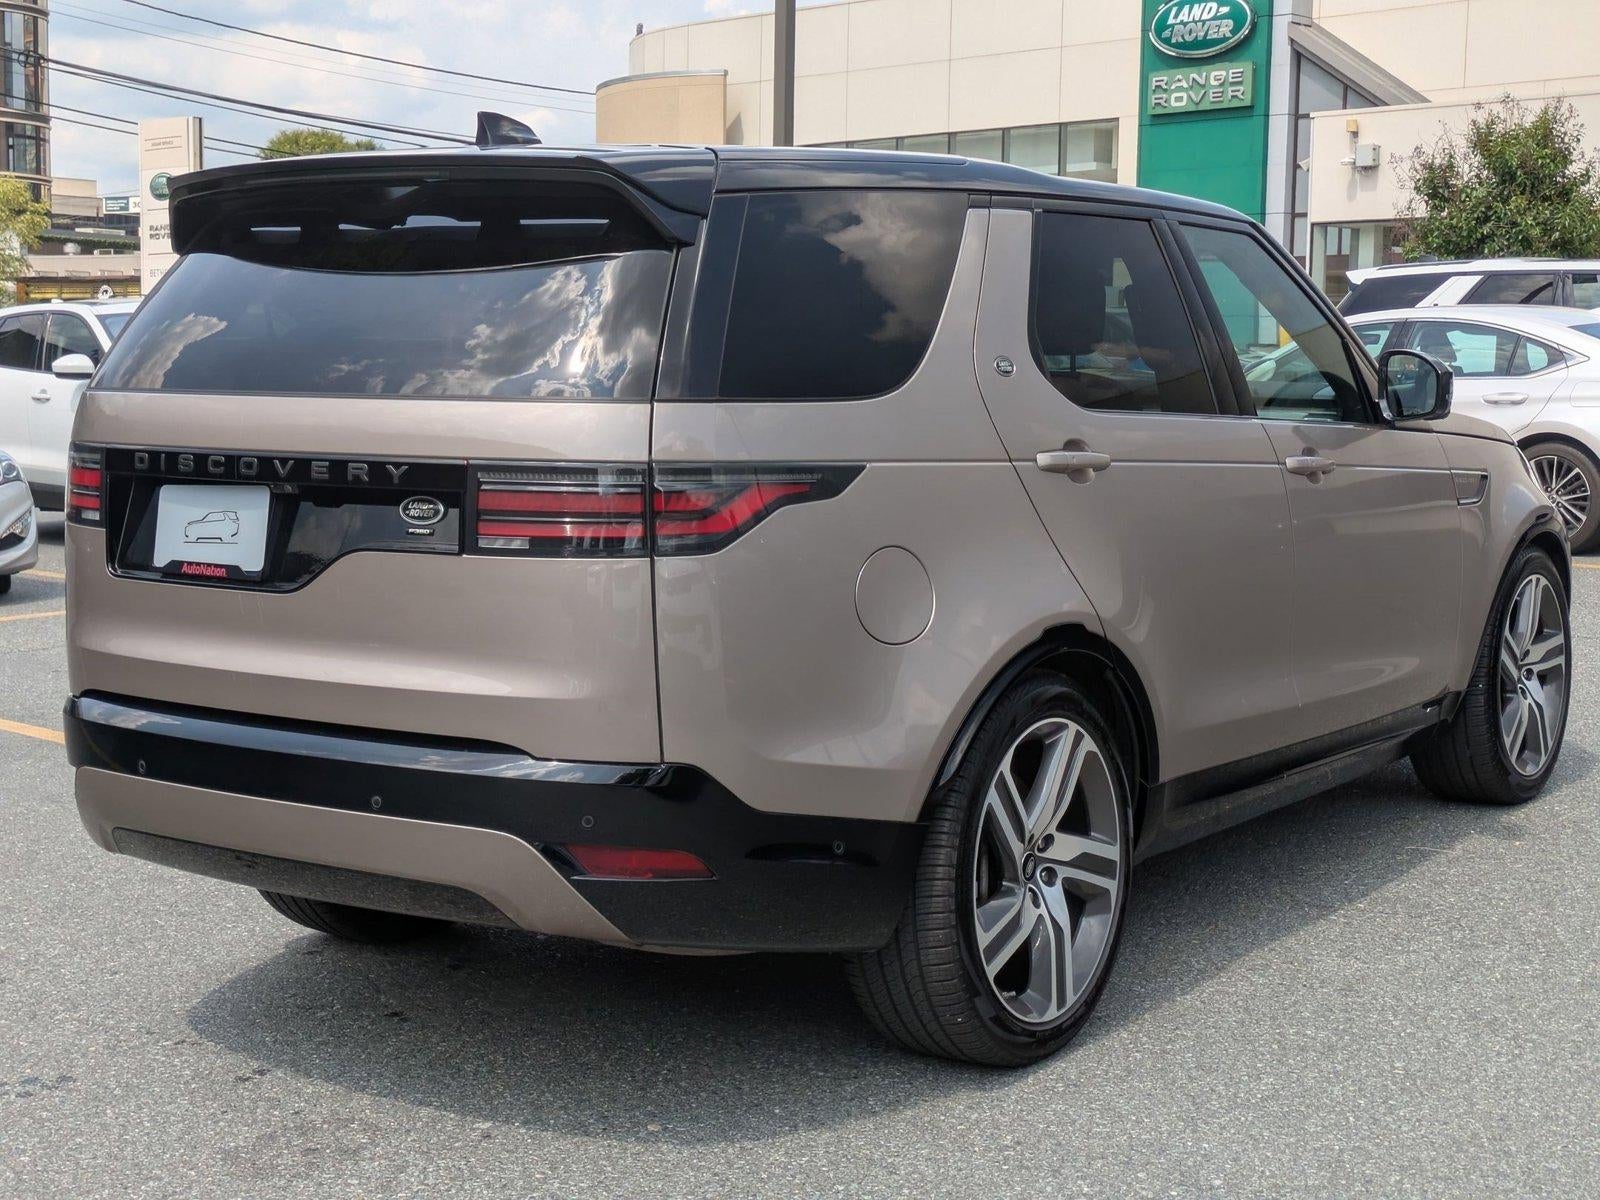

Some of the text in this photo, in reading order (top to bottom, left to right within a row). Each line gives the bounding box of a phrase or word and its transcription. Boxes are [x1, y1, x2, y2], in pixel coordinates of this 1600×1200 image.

[1166, 2, 1218, 25] LAND
[1171, 19, 1234, 43] ROVER
[1152, 68, 1244, 91] RANGE
[1152, 86, 1245, 108] ROVER
[149, 224, 170, 232] RANG
[149, 232, 171, 240] ROVE
[134, 451, 409, 484] DISCOVERY
[409, 509, 434, 517] ROVER
[181, 562, 227, 577] AutoNation
